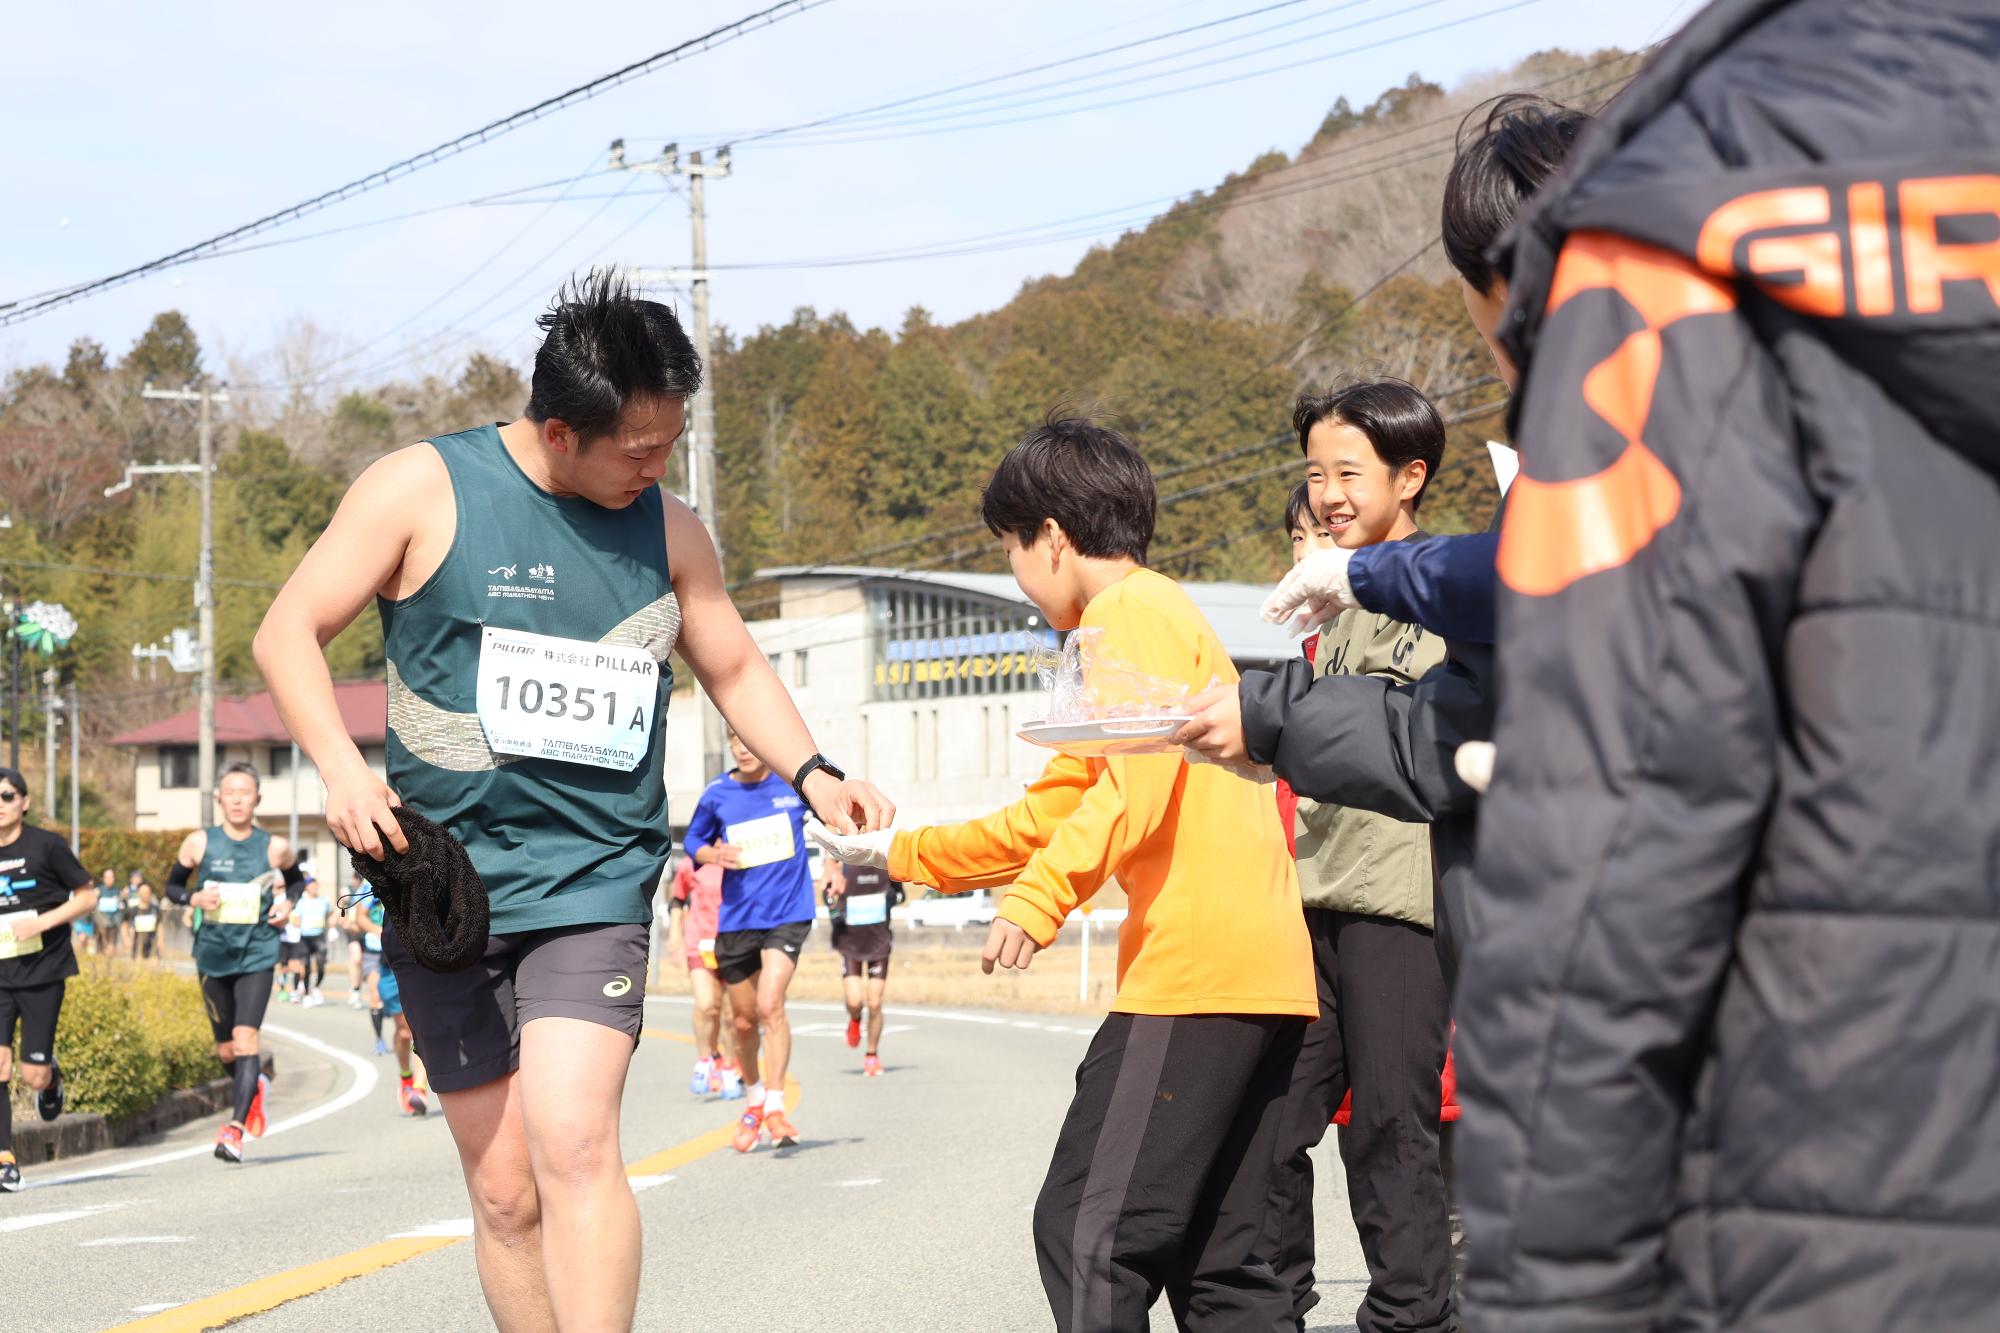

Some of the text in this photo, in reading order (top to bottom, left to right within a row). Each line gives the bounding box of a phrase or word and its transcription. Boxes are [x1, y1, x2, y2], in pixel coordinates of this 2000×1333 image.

[1696, 173, 2000, 318] GIR
[488, 585, 554, 596] TAMBASASAYAMA
[492, 642, 536, 655] PILLAR
[544, 649, 653, 675] 株式会社 PILLAR
[496, 675, 645, 732] 10351 A
[540, 748, 560, 757] ABC
[562, 751, 610, 764] MARATHON
[542, 738, 635, 761] TAMBASASAYAMA
